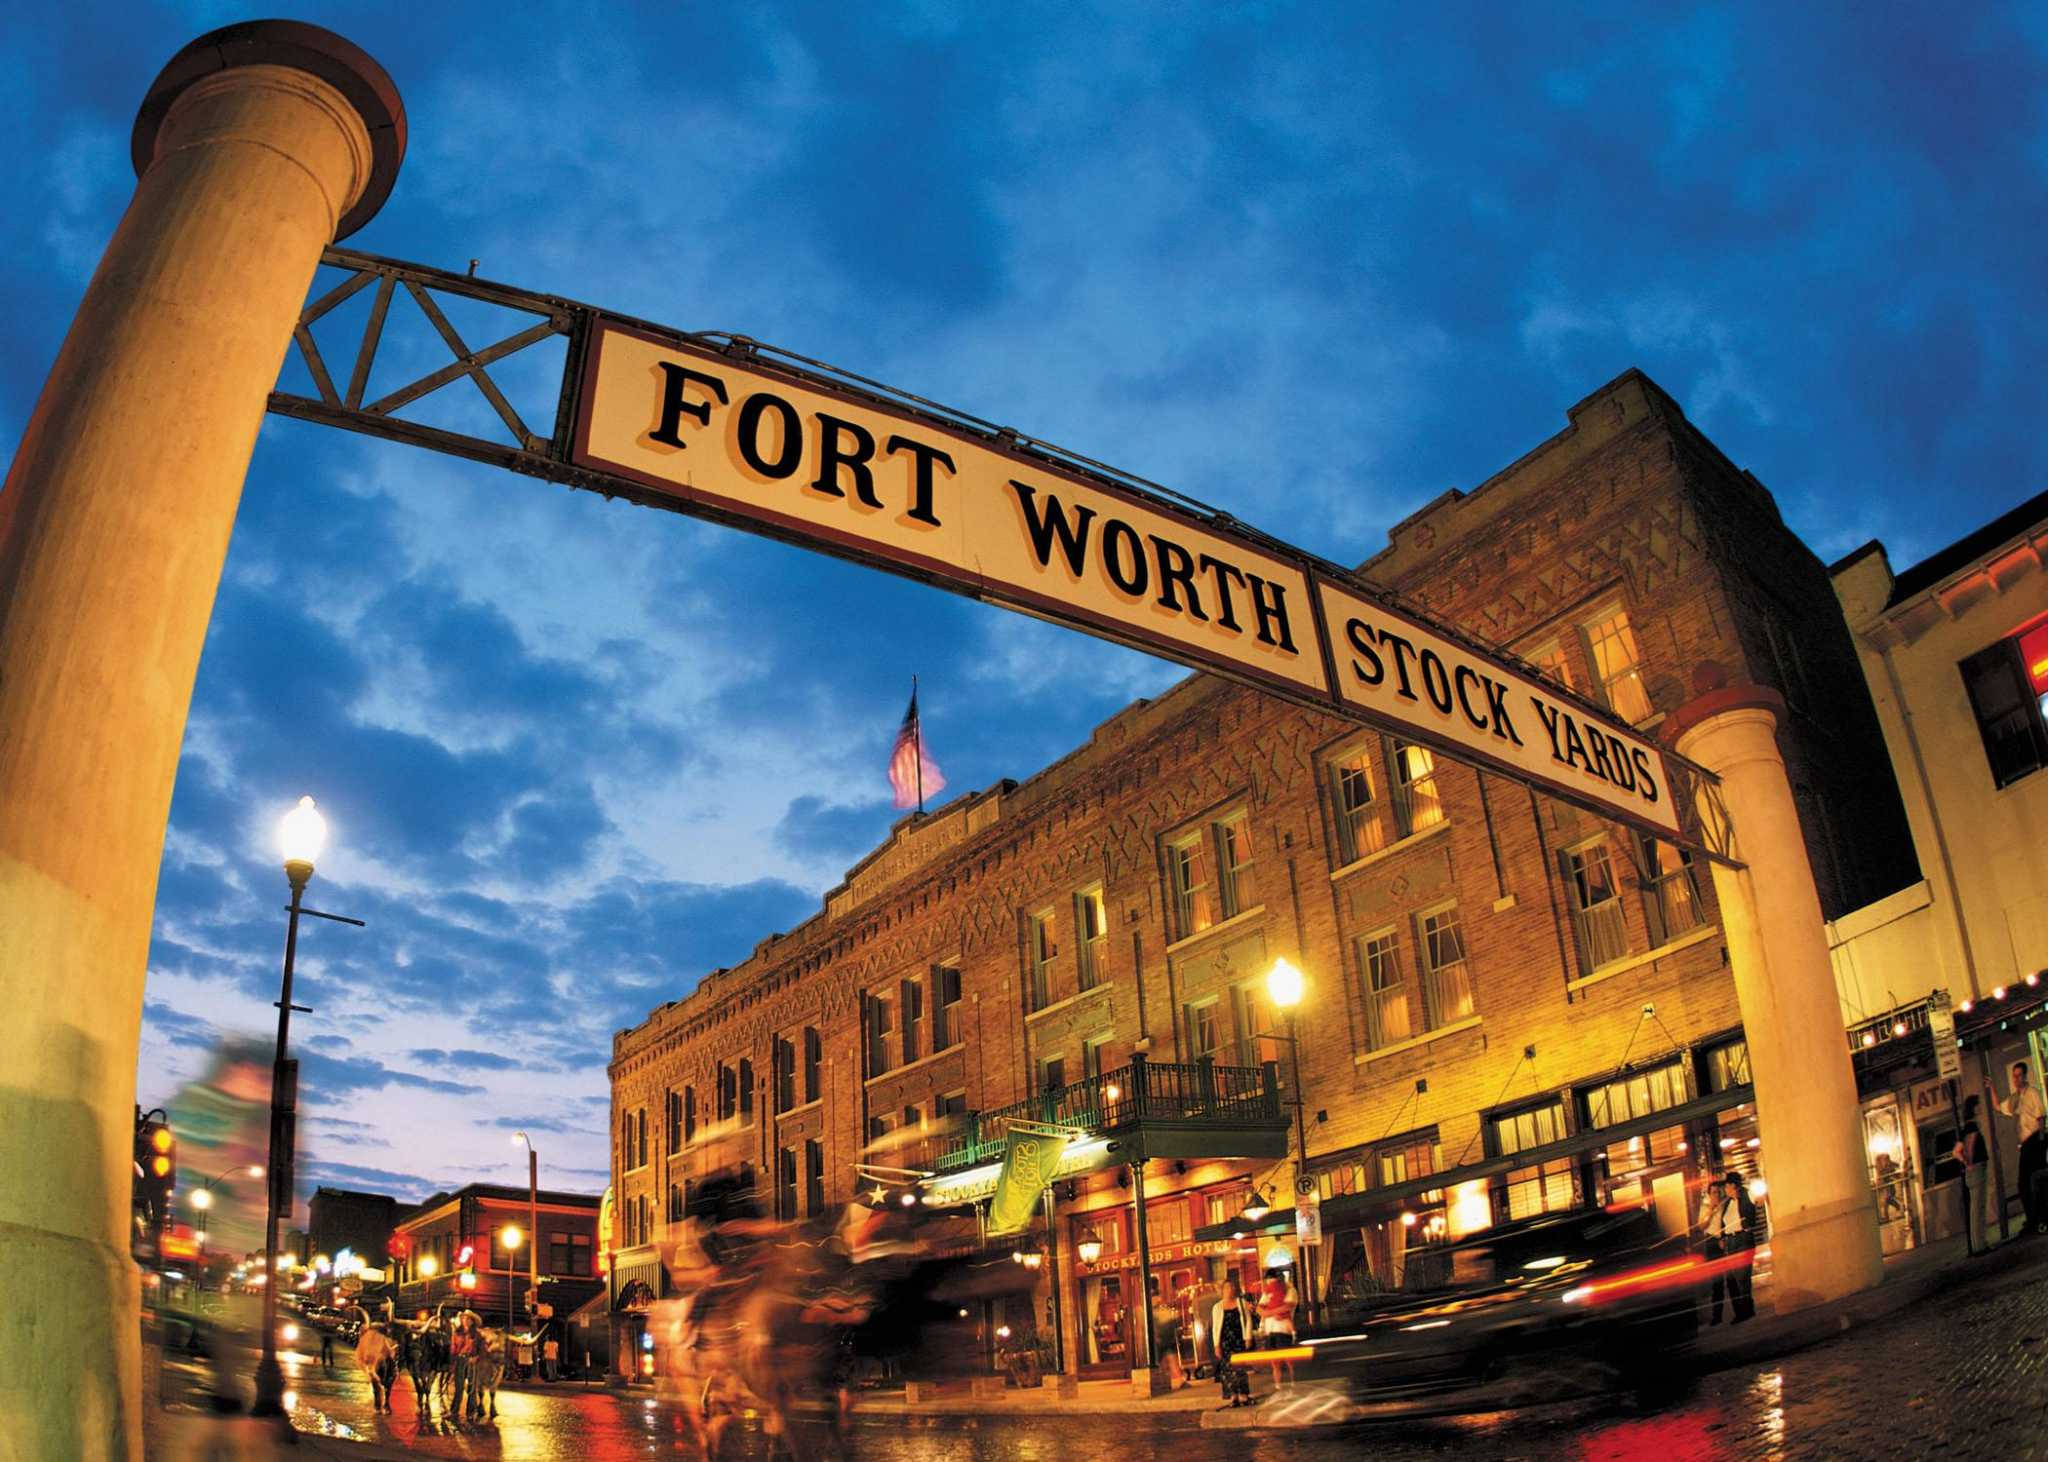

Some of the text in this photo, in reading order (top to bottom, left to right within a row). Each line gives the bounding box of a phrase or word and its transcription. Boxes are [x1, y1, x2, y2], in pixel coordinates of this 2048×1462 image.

[648, 360, 1658, 803] FORT WORTH STOCK YARDS
[1183, 1239, 1232, 1257] HOTEL
